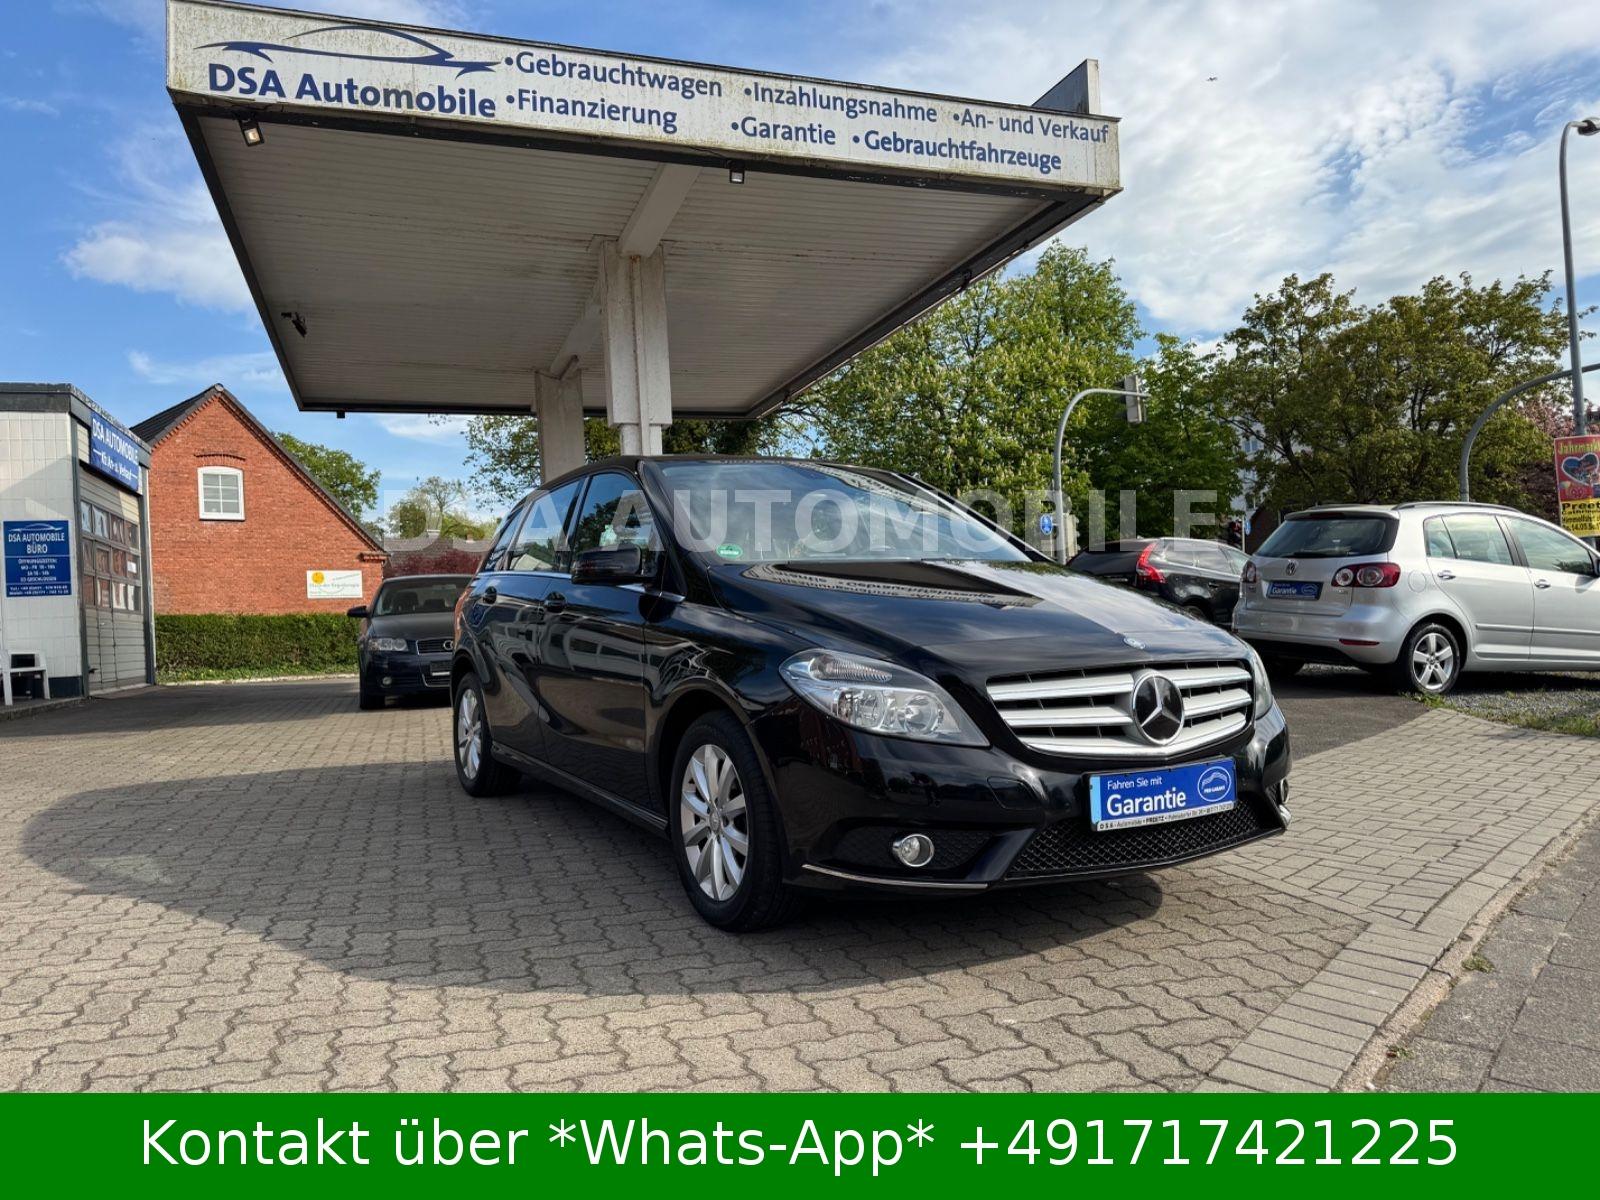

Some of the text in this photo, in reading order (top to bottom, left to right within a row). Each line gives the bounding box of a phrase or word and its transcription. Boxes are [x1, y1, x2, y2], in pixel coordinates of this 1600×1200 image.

[208, 63, 496, 119] DSA Automobile
[515, 51, 723, 101] Gebrauchtwagen
[518, 88, 679, 133] Finanzierung
[753, 82, 938, 123] Inzahlungsnahme
[740, 117, 837, 146] Garantie
[960, 107, 1109, 144] An- und Verkauf
[864, 130, 1062, 173] Gebrauchtfahrzeuge
[22, 533, 64, 541] AUTOMOBILE
[26, 541, 48, 553] BÜRO
[1107, 776, 1163, 791] Fahren Sie mit
[1107, 787, 1186, 815] Garantie
